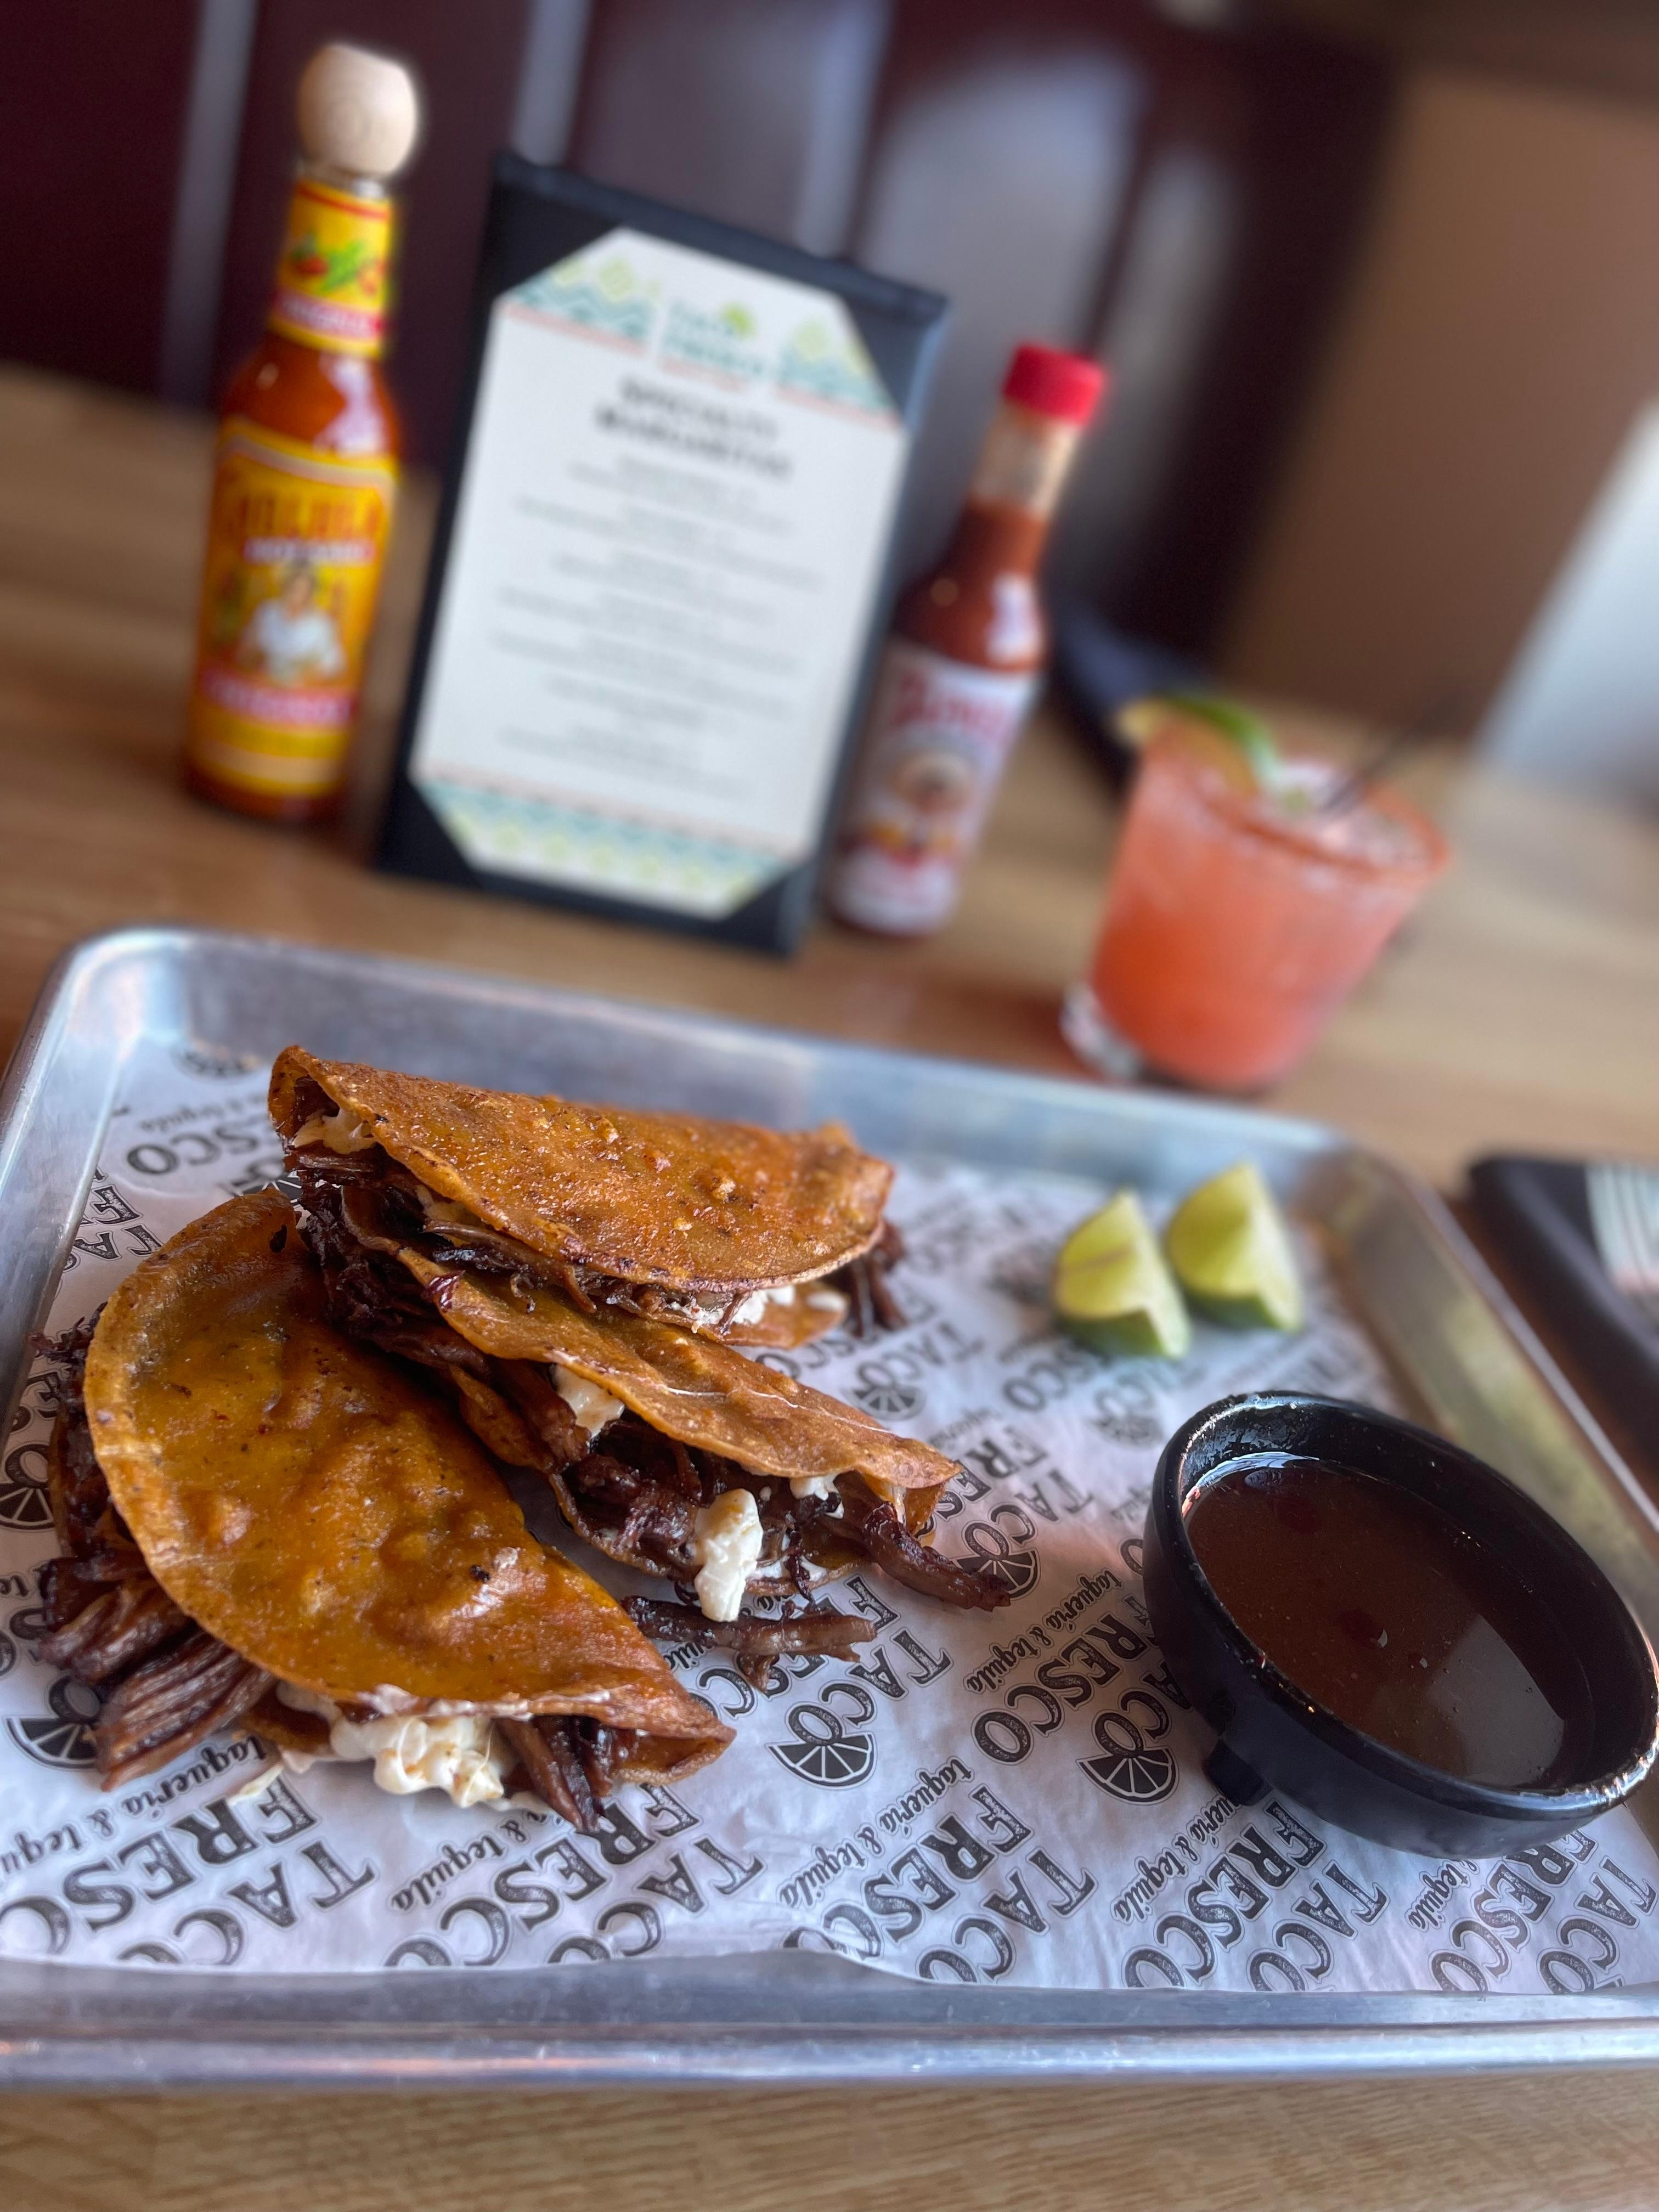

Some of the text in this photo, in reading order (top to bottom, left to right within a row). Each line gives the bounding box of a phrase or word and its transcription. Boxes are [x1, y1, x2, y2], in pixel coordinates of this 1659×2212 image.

[964, 1469, 1094, 1562] TACO
[788, 1629, 952, 1746] TACO
[966, 1570, 1122, 1691] taqueria & tequila
[1094, 1662, 1193, 1758] ACO
[0, 1736, 266, 1875] taqueria & tequ
[0, 1775, 317, 1954] FRESC
[391, 1820, 526, 1911] & tequila
[779, 1759, 972, 1906] taqueria & tequila
[1114, 1797, 1242, 1921] ueria & tequila
[1250, 1865, 1387, 1991] TACO
[1408, 1865, 1469, 1928] tequila
[1539, 1858, 1657, 1995] TACO
